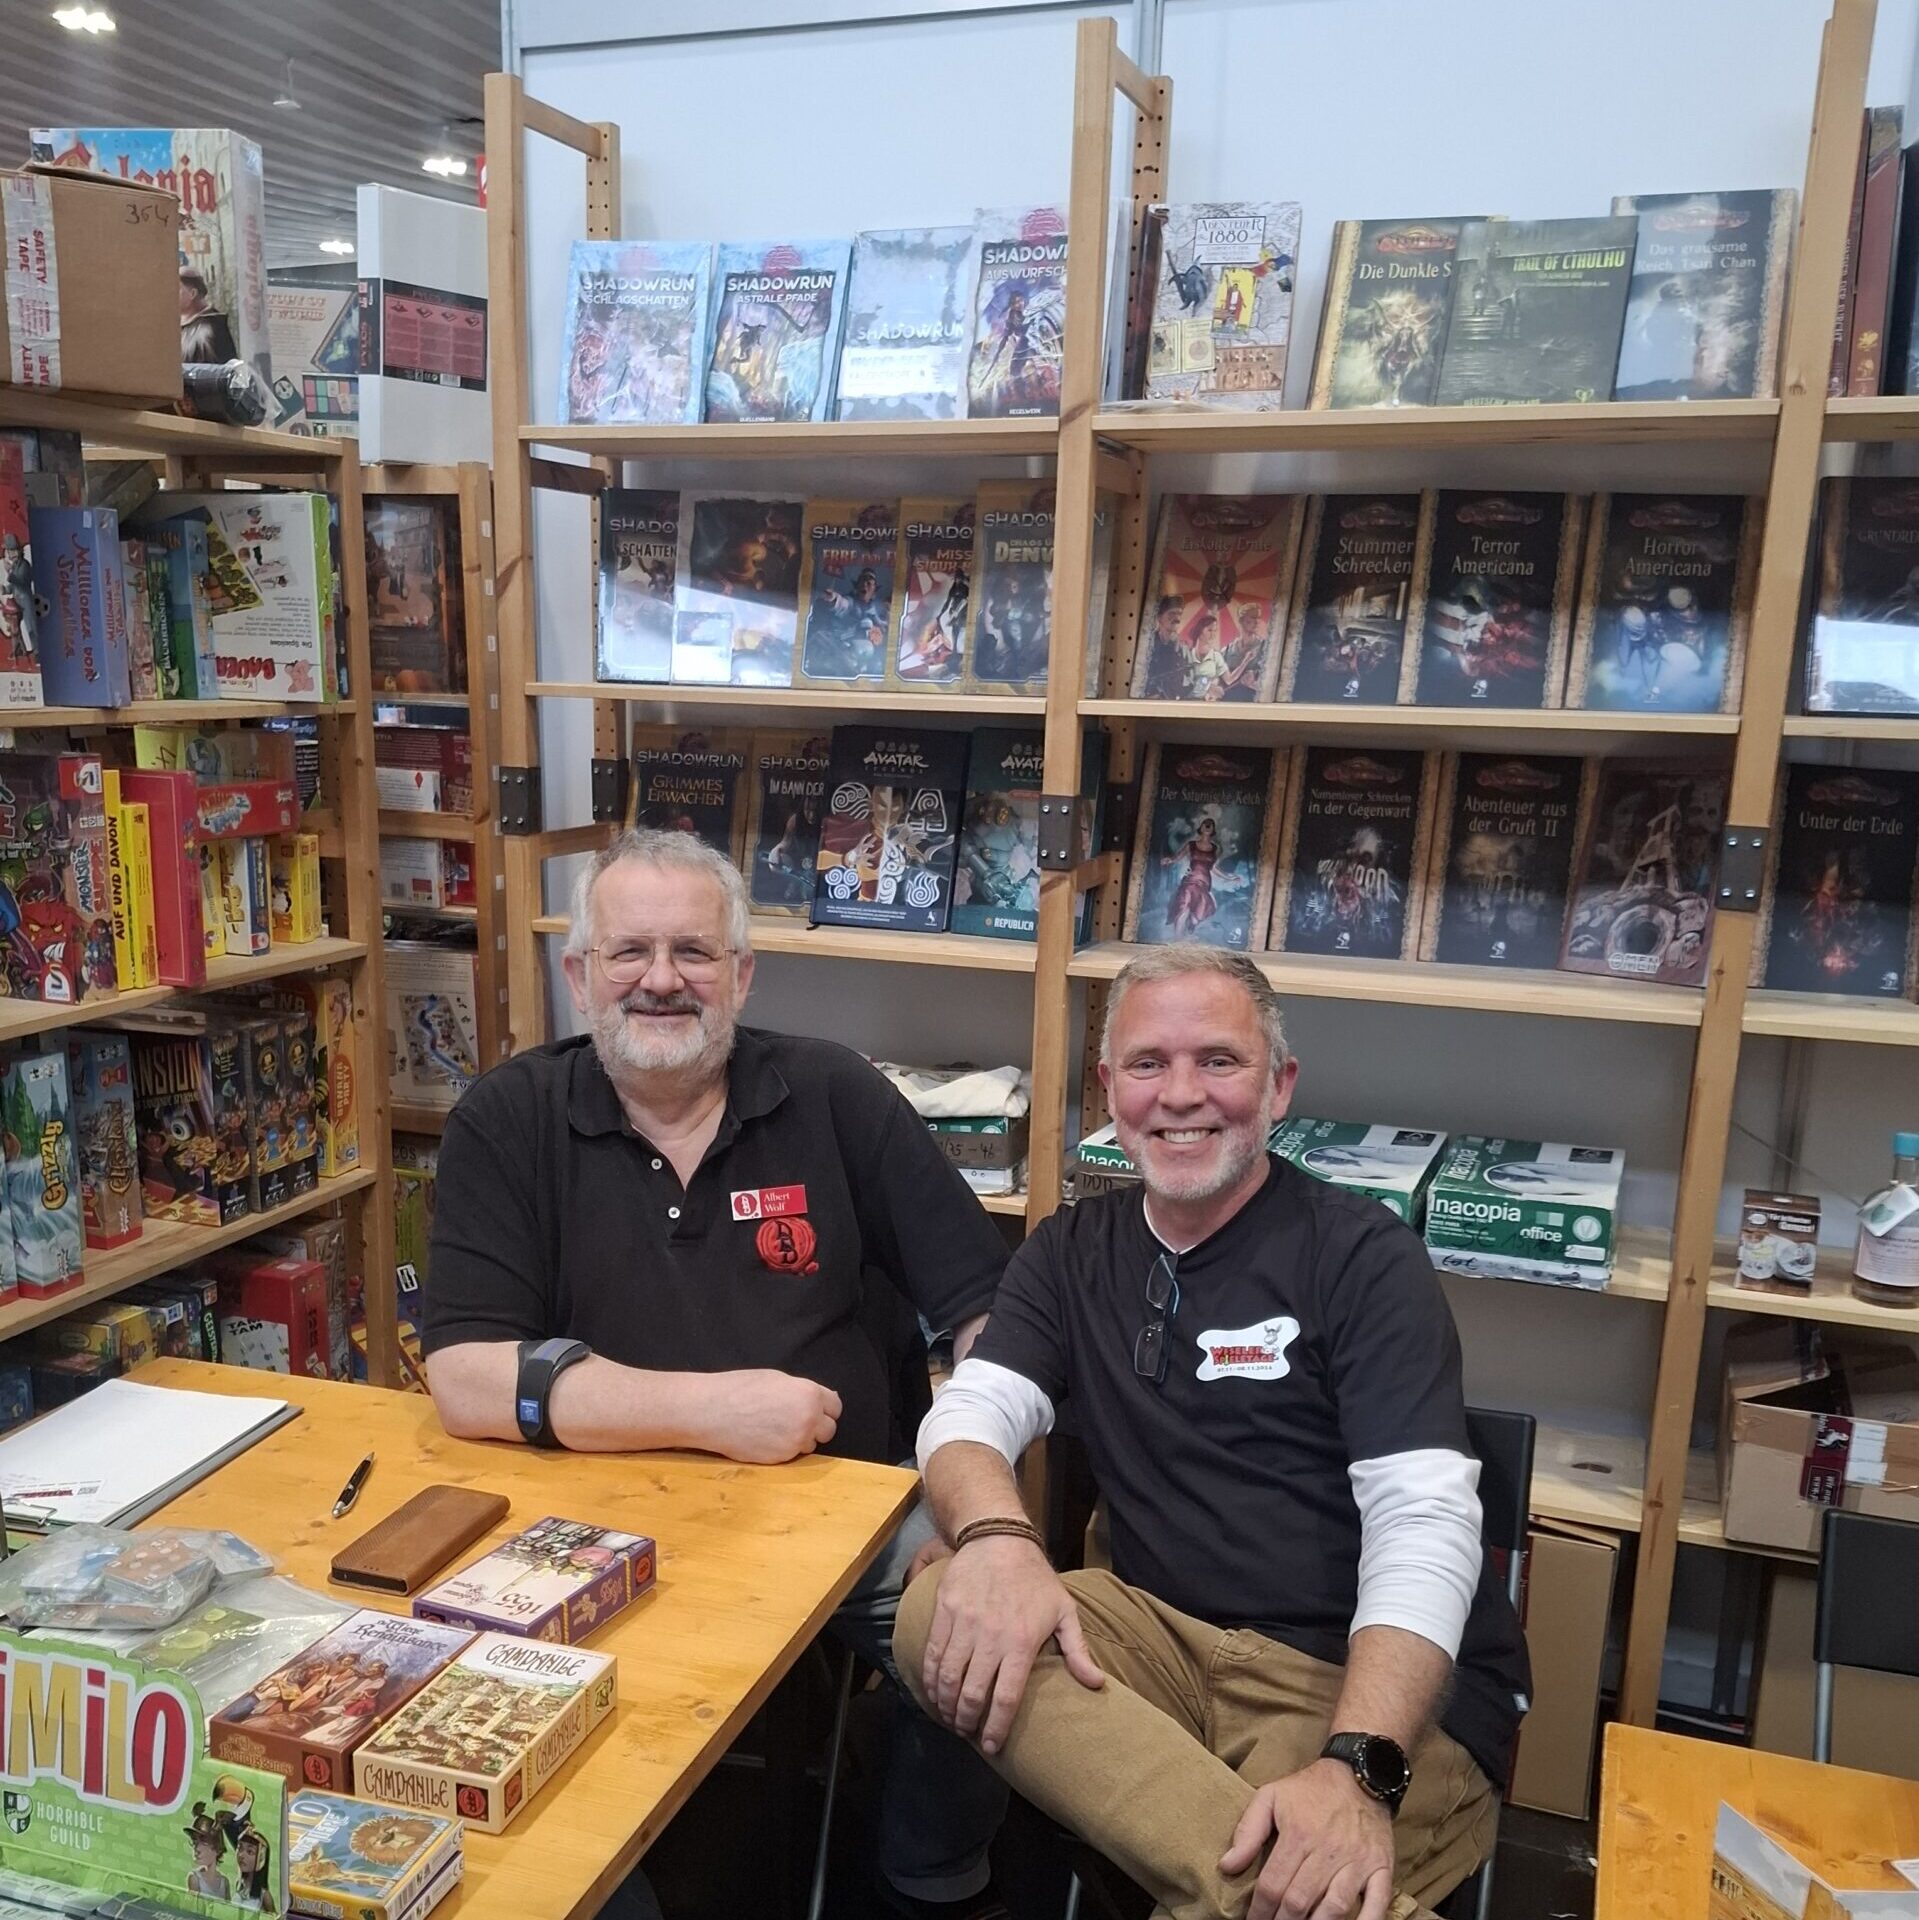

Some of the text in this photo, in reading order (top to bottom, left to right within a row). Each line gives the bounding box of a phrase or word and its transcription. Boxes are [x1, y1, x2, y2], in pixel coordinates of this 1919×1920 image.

[1209, 230, 1248, 244] 1880
[18, 236, 31, 275] TAPE
[33, 229, 48, 285] SAFETY
[1650, 242, 1748, 256] Das grausame
[1359, 265, 1384, 279] Die
[1388, 263, 1438, 279] Dunkle
[1513, 250, 1626, 273] TRAIL OF CTHULHU
[1720, 256, 1756, 268] Chan
[582, 277, 696, 292] SHADOWRUN
[727, 275, 834, 292] SHADOWRUN
[584, 294, 690, 305] SCHLAGSCHATTEN
[737, 292, 818, 304] ASTRALE PFADE
[1338, 538, 1414, 555] Stummer
[1471, 536, 1520, 555] Terror
[1643, 537, 1699, 556] Horror
[1332, 556, 1412, 576] Schrecken
[1452, 556, 1534, 577] Americana
[1624, 559, 1712, 578] Americana
[160, 592, 173, 669] BAUMKRONEN
[637, 750, 744, 769] SHADOWRUN
[863, 751, 930, 768] AVATAR
[653, 775, 723, 792] GRIMMES
[781, 778, 806, 797] BANN
[806, 781, 825, 796] DER
[648, 788, 725, 806] ERWACHEN
[1160, 787, 1177, 801] Der
[1367, 791, 1412, 804] Schrecken
[1308, 801, 1411, 821] in der Gegenwart
[1464, 795, 1567, 817] Abenteuer aus
[1469, 816, 1559, 837] der Gruft II
[1800, 811, 1903, 835] Unter der Erde
[71, 839, 93, 913] MONSTER
[107, 816, 125, 940] AUF UND DAVON
[993, 917, 1035, 932] REPUBLICA
[42, 1119, 65, 1210] Grizzly
[1448, 1149, 1480, 1181] Inacopia
[764, 1192, 790, 1203] Albert
[764, 1202, 786, 1213] Wolf
[1431, 1194, 1521, 1223] Inacopia
[1519, 1226, 1562, 1243] office
[227, 1319, 261, 1329] TAM
[231, 1322, 263, 1336] TAM
[1213, 1353, 1275, 1366] SPIELETAGE
[499, 1591, 543, 1618] 1655
[348, 1624, 449, 1652] Renaissance
[485, 1643, 586, 1677] CAMPANILE
[363, 1763, 449, 1809] CAMPANILE
[36, 1801, 104, 1833] HORRIBLE
[50, 1825, 91, 1850] GUILD
